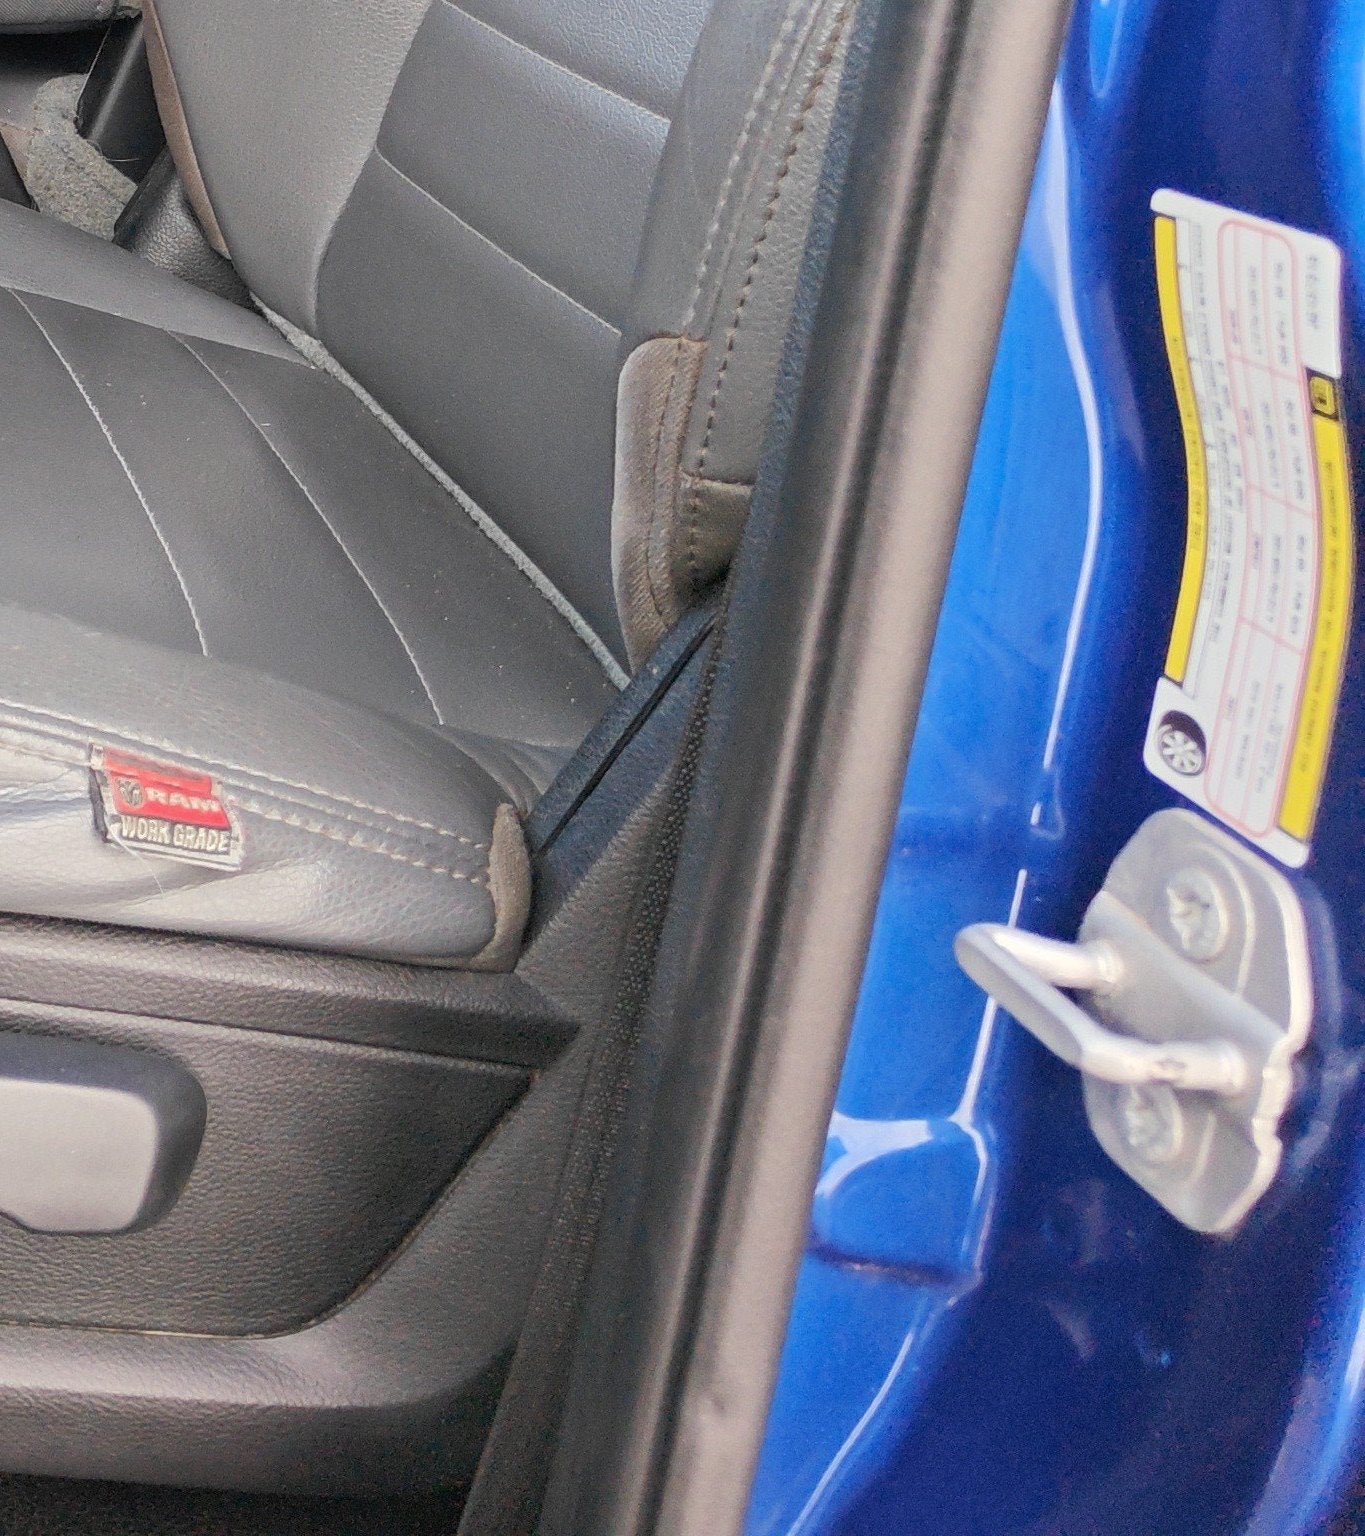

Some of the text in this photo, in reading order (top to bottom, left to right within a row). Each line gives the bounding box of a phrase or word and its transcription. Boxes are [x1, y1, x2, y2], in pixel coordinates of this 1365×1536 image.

[145, 787, 218, 811] RAM
[121, 817, 230, 851] WORK GRADE
